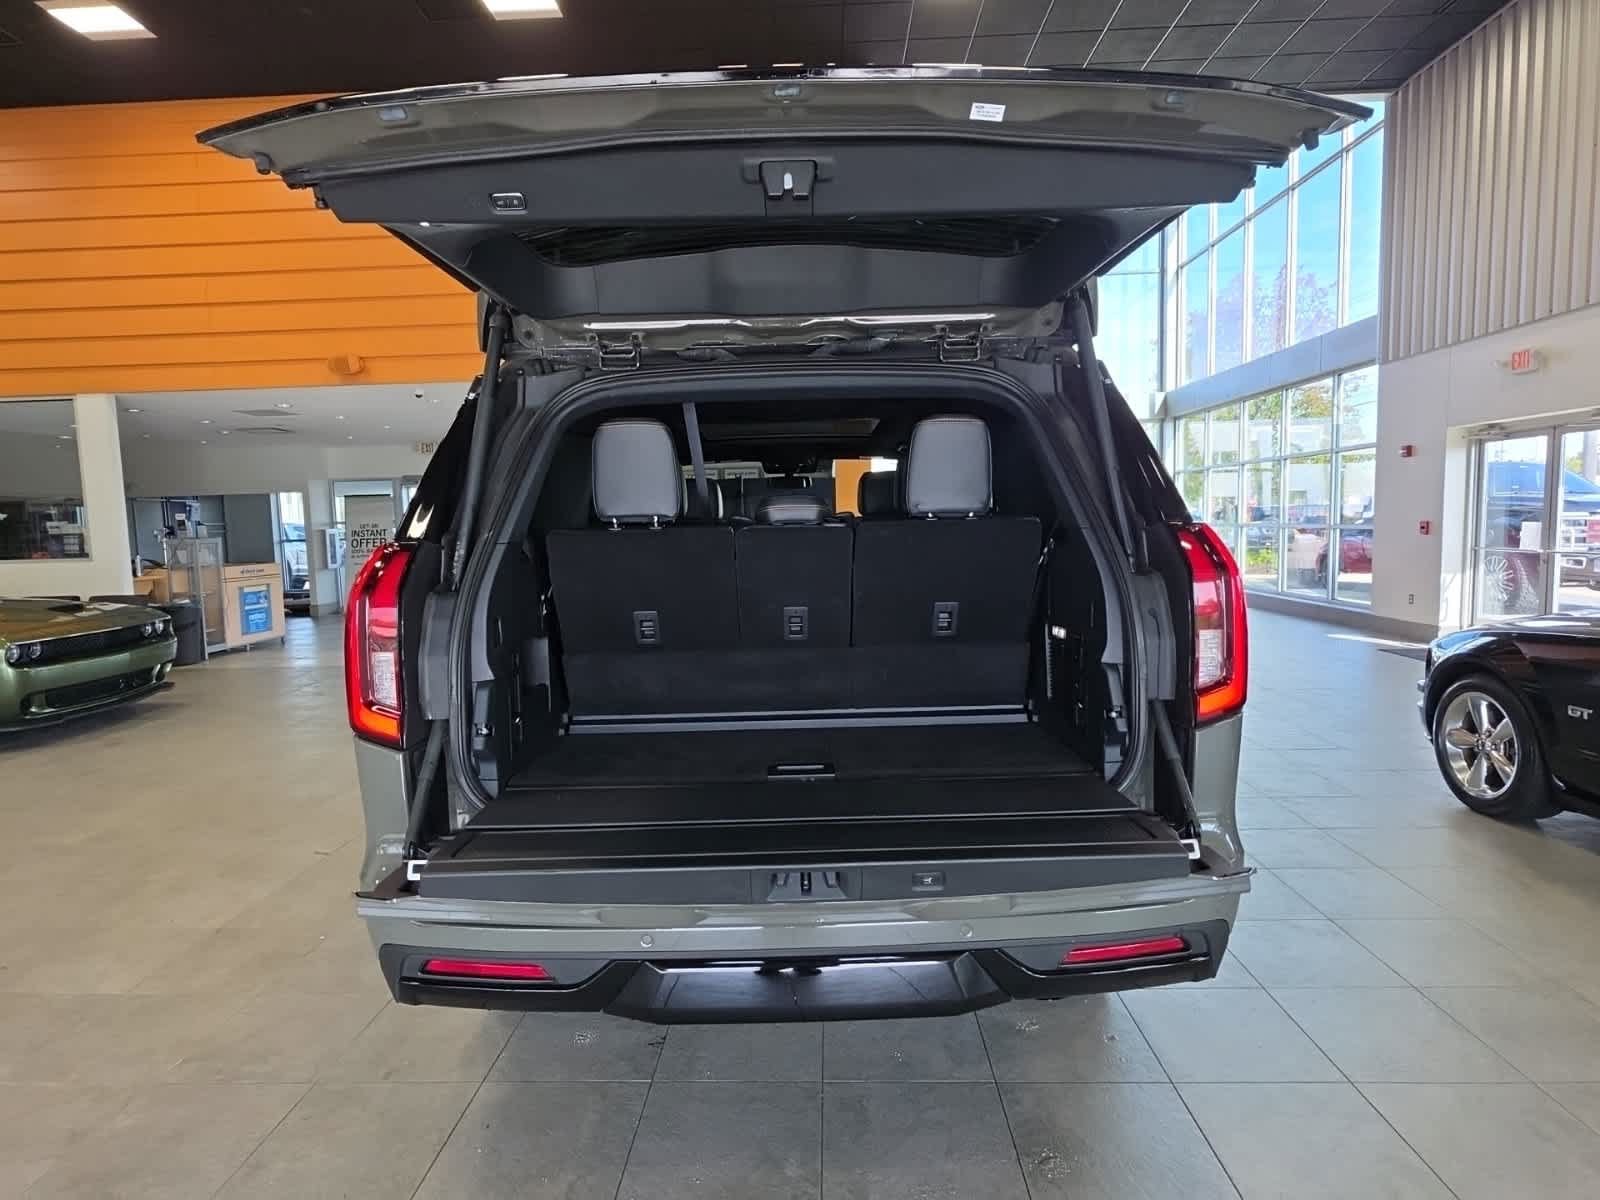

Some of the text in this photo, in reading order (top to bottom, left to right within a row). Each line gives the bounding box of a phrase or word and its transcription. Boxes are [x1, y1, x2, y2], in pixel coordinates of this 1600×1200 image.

[1512, 350, 1530, 369] EXIT
[351, 529, 387, 537] INSTANT
[1568, 704, 1593, 720] GT
